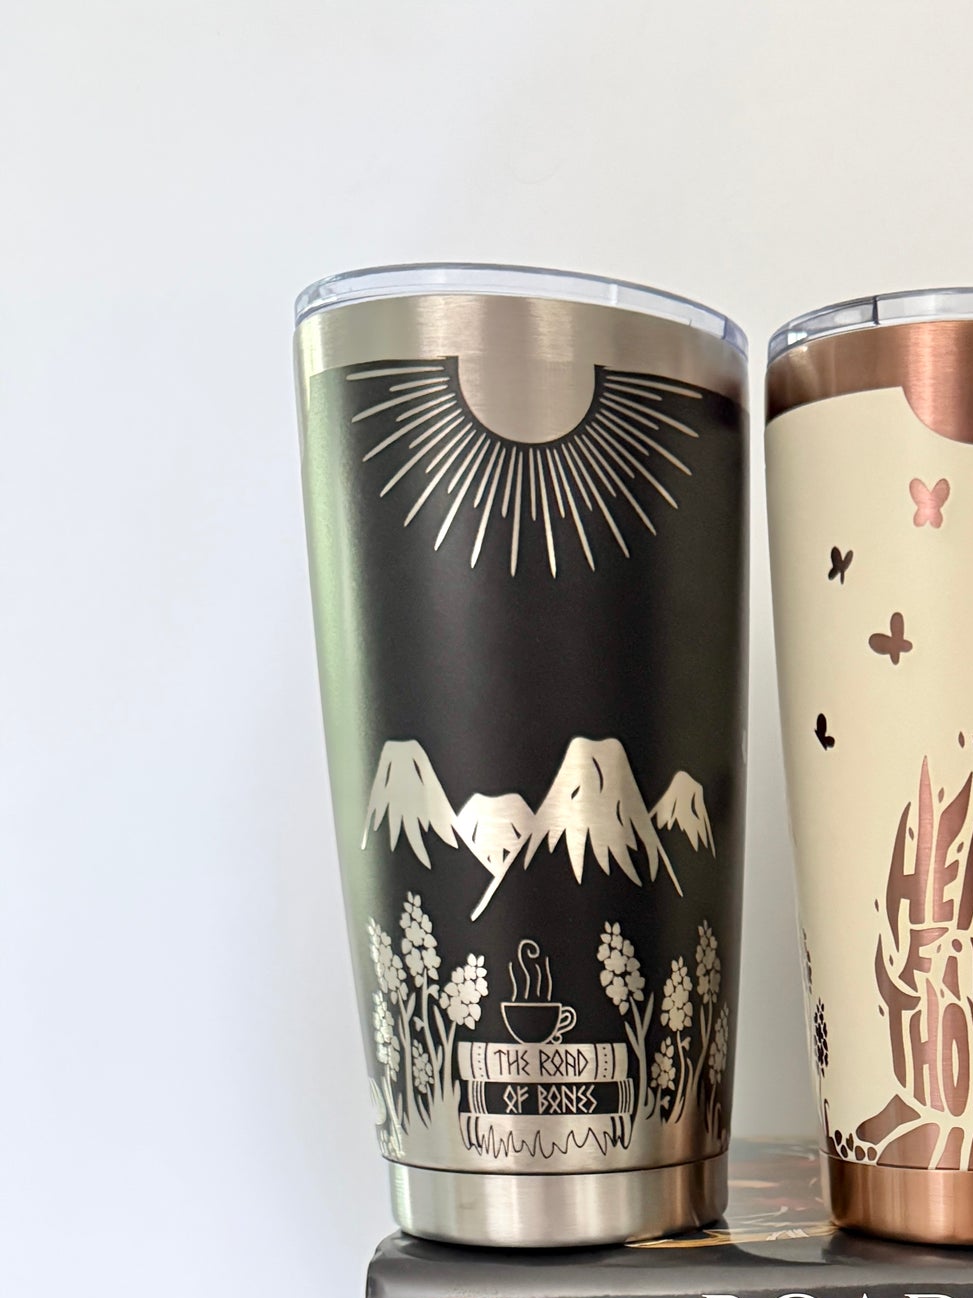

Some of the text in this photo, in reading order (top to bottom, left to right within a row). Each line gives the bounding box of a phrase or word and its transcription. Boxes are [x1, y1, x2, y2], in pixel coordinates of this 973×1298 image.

[538, 1048, 589, 1077] ROAD
[502, 1084, 598, 1115] OF BONES
